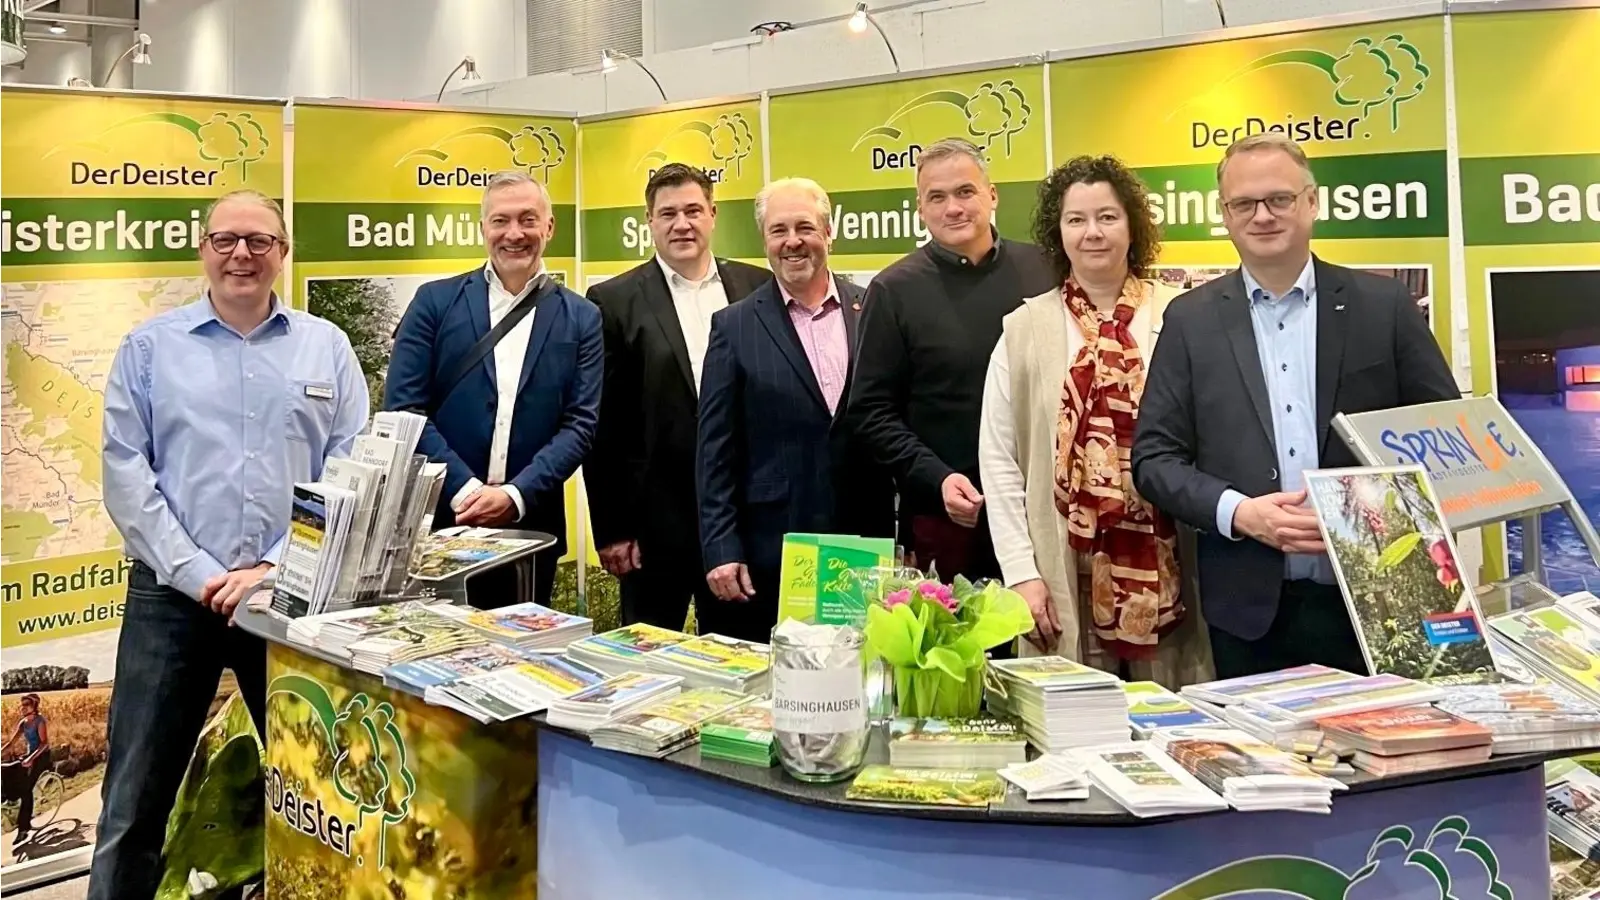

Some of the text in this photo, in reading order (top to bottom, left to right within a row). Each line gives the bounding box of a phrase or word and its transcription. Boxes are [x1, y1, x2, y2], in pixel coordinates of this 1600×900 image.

[71, 161, 226, 186] DerDeister.
[347, 213, 415, 247] Bad
[623, 217, 655, 256] Sp
[828, 557, 848, 570] Die
[775, 697, 860, 713] BARSINGHAUSEN
